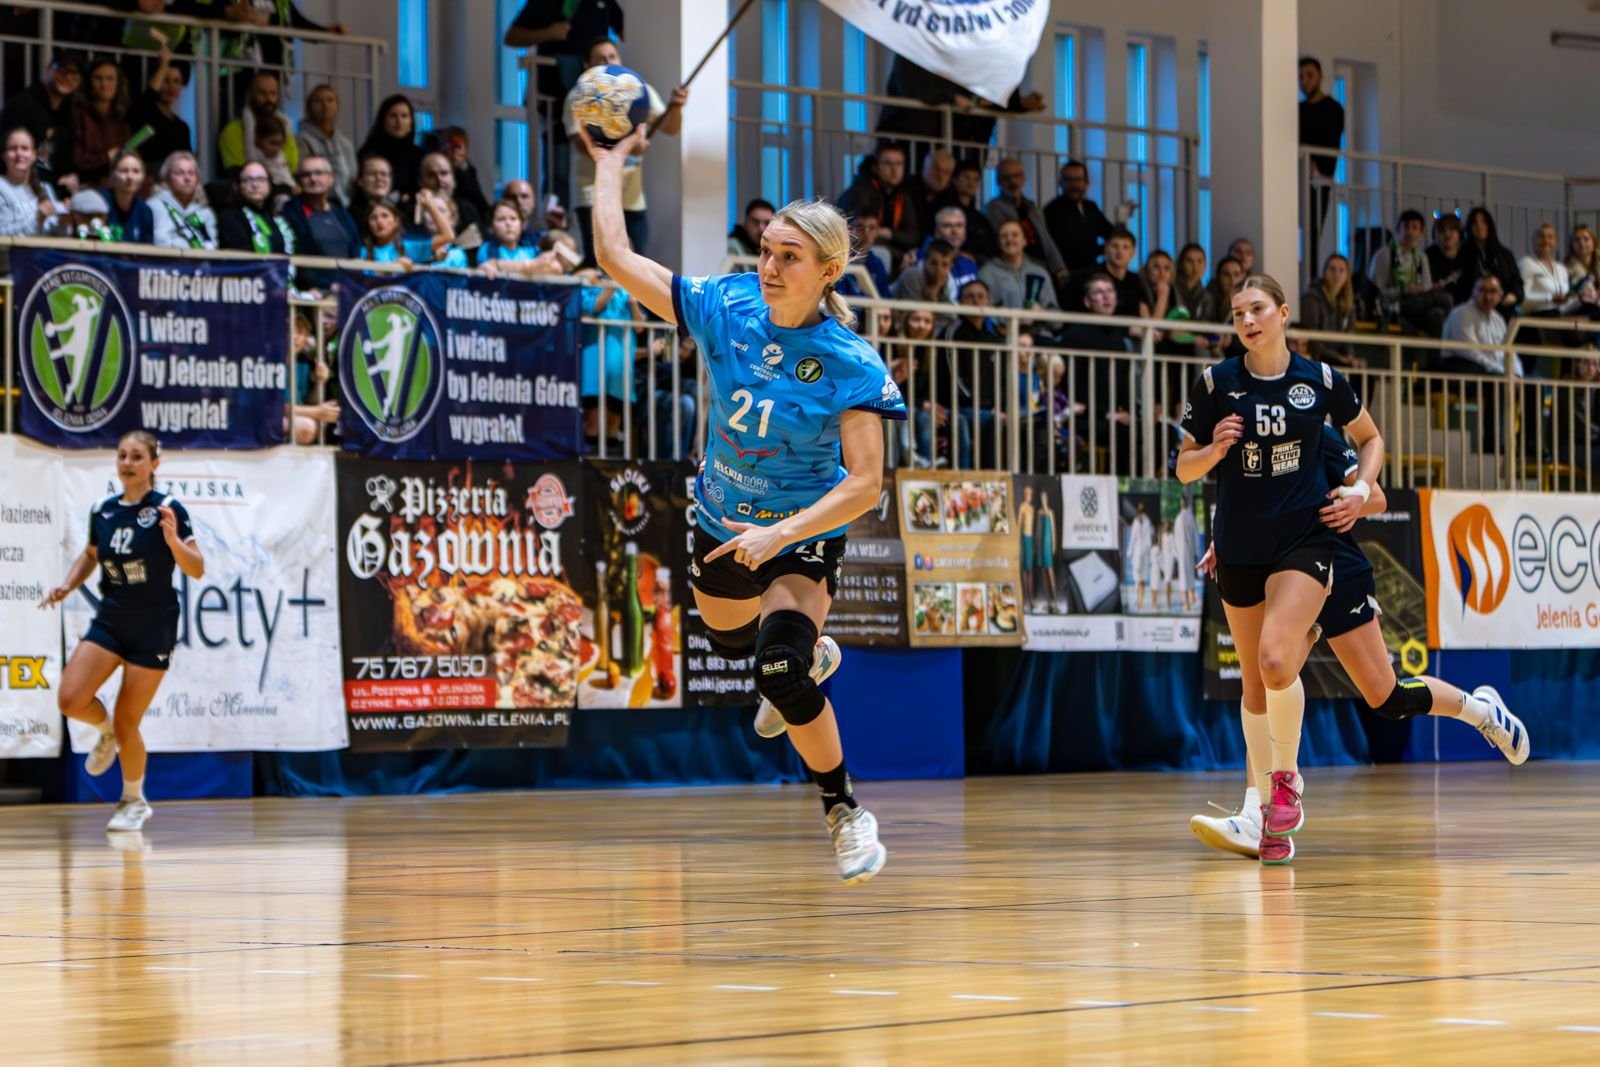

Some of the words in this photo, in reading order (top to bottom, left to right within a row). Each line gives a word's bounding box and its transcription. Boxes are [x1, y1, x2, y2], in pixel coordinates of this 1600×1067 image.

[138, 267, 218, 302] Kibiców
[221, 277, 266, 304] moc
[446, 288, 518, 324] Kibiców
[519, 299, 560, 327] moc
[138, 310, 147, 343] i
[150, 312, 208, 345] wiara
[446, 329, 455, 359] i
[455, 332, 507, 363] wiara
[140, 357, 168, 390] by
[169, 354, 239, 389] Jelenia
[241, 356, 287, 389] Góra
[447, 370, 470, 404] by
[471, 370, 532, 405] Jelenia
[535, 374, 578, 407] Góra
[728, 389, 775, 438] 21
[1255, 404, 1287, 437] 53
[1272, 449, 1299, 462] ACTIVE
[1273, 460, 1299, 472] WEAR
[400, 476, 508, 524] Pizzeria
[0, 546, 24, 562] cza
[109, 527, 134, 555] 42
[347, 512, 564, 590] Gazownia
[1512, 513, 1600, 594] ec
[1536, 602, 1582, 630] Jelenia
[1585, 602, 1600, 629] G
[352, 657, 385, 680] 75
[386, 656, 432, 679] 767
[761, 659, 788, 673] SELECT
